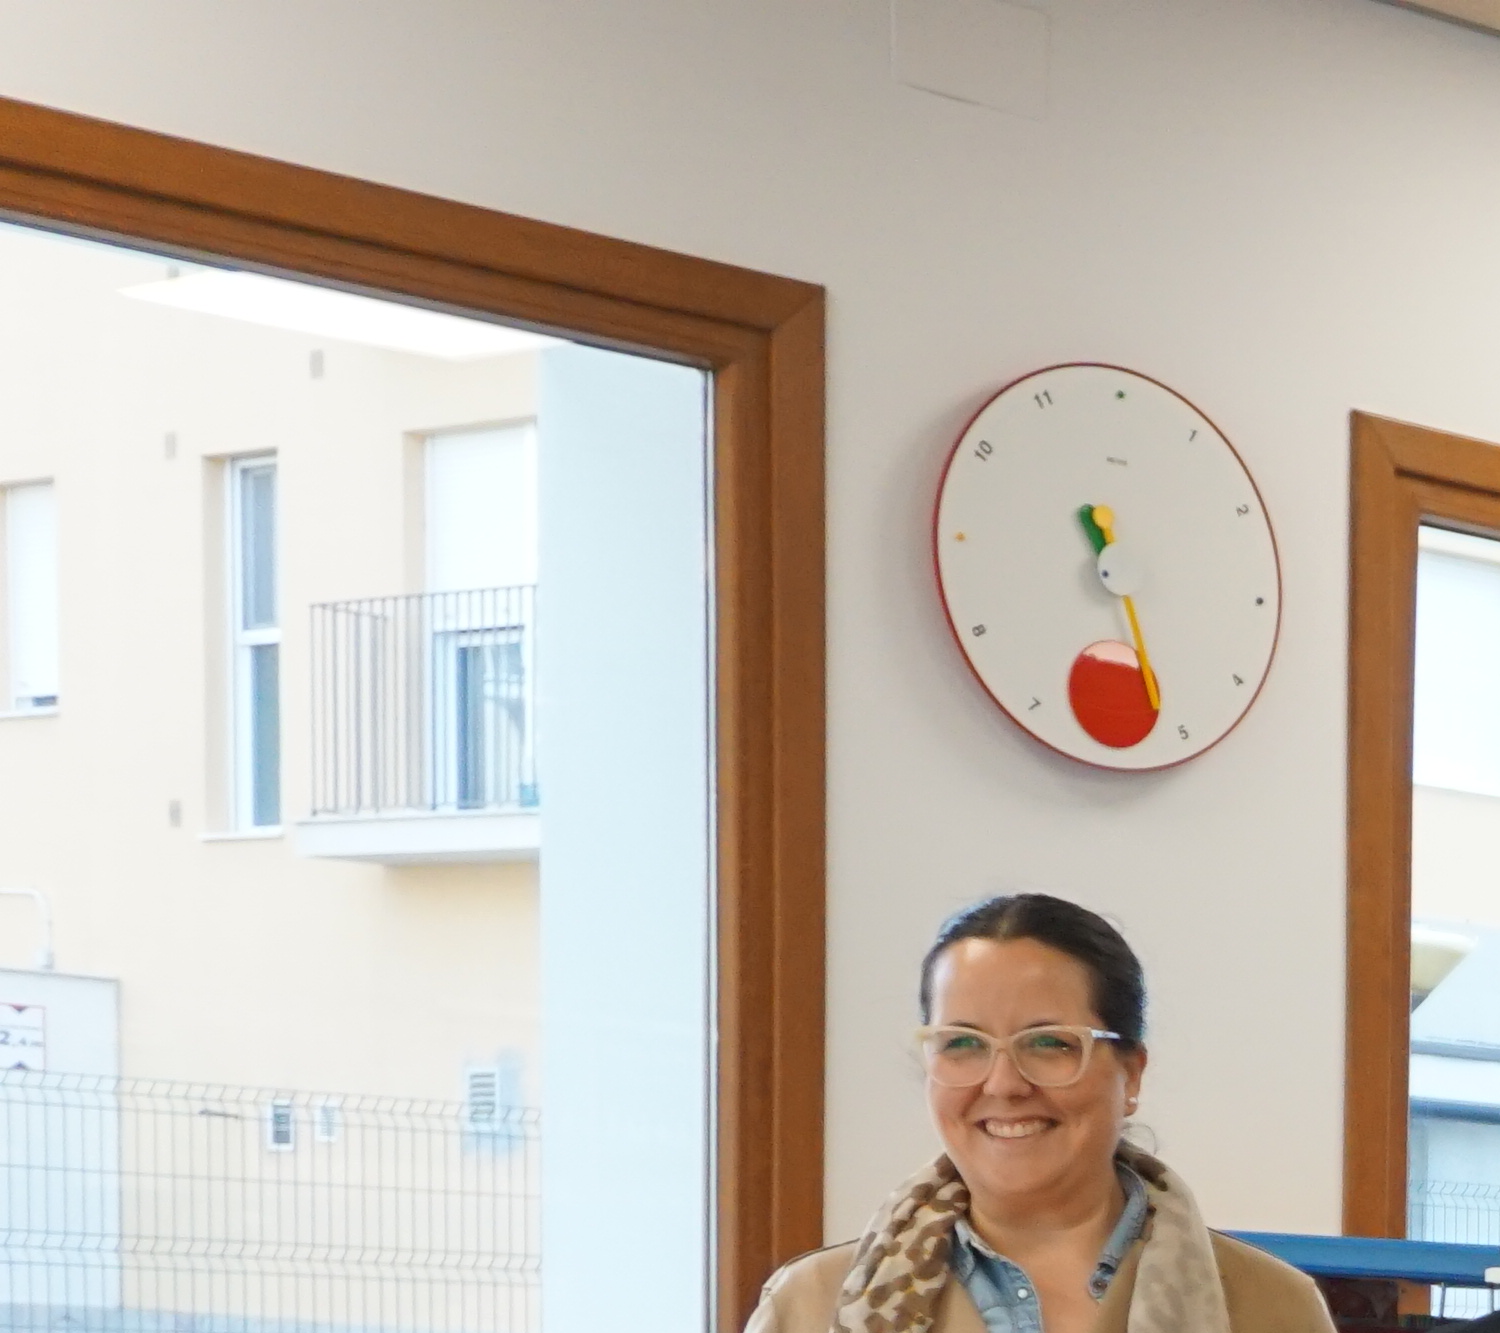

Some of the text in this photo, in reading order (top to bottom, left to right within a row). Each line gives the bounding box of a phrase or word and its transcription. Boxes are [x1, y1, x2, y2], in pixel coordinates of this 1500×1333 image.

[1033, 390, 1054, 408] 11
[1188, 429, 1198, 443] 1
[974, 440, 994, 462] 10
[1236, 504, 1250, 516] 2
